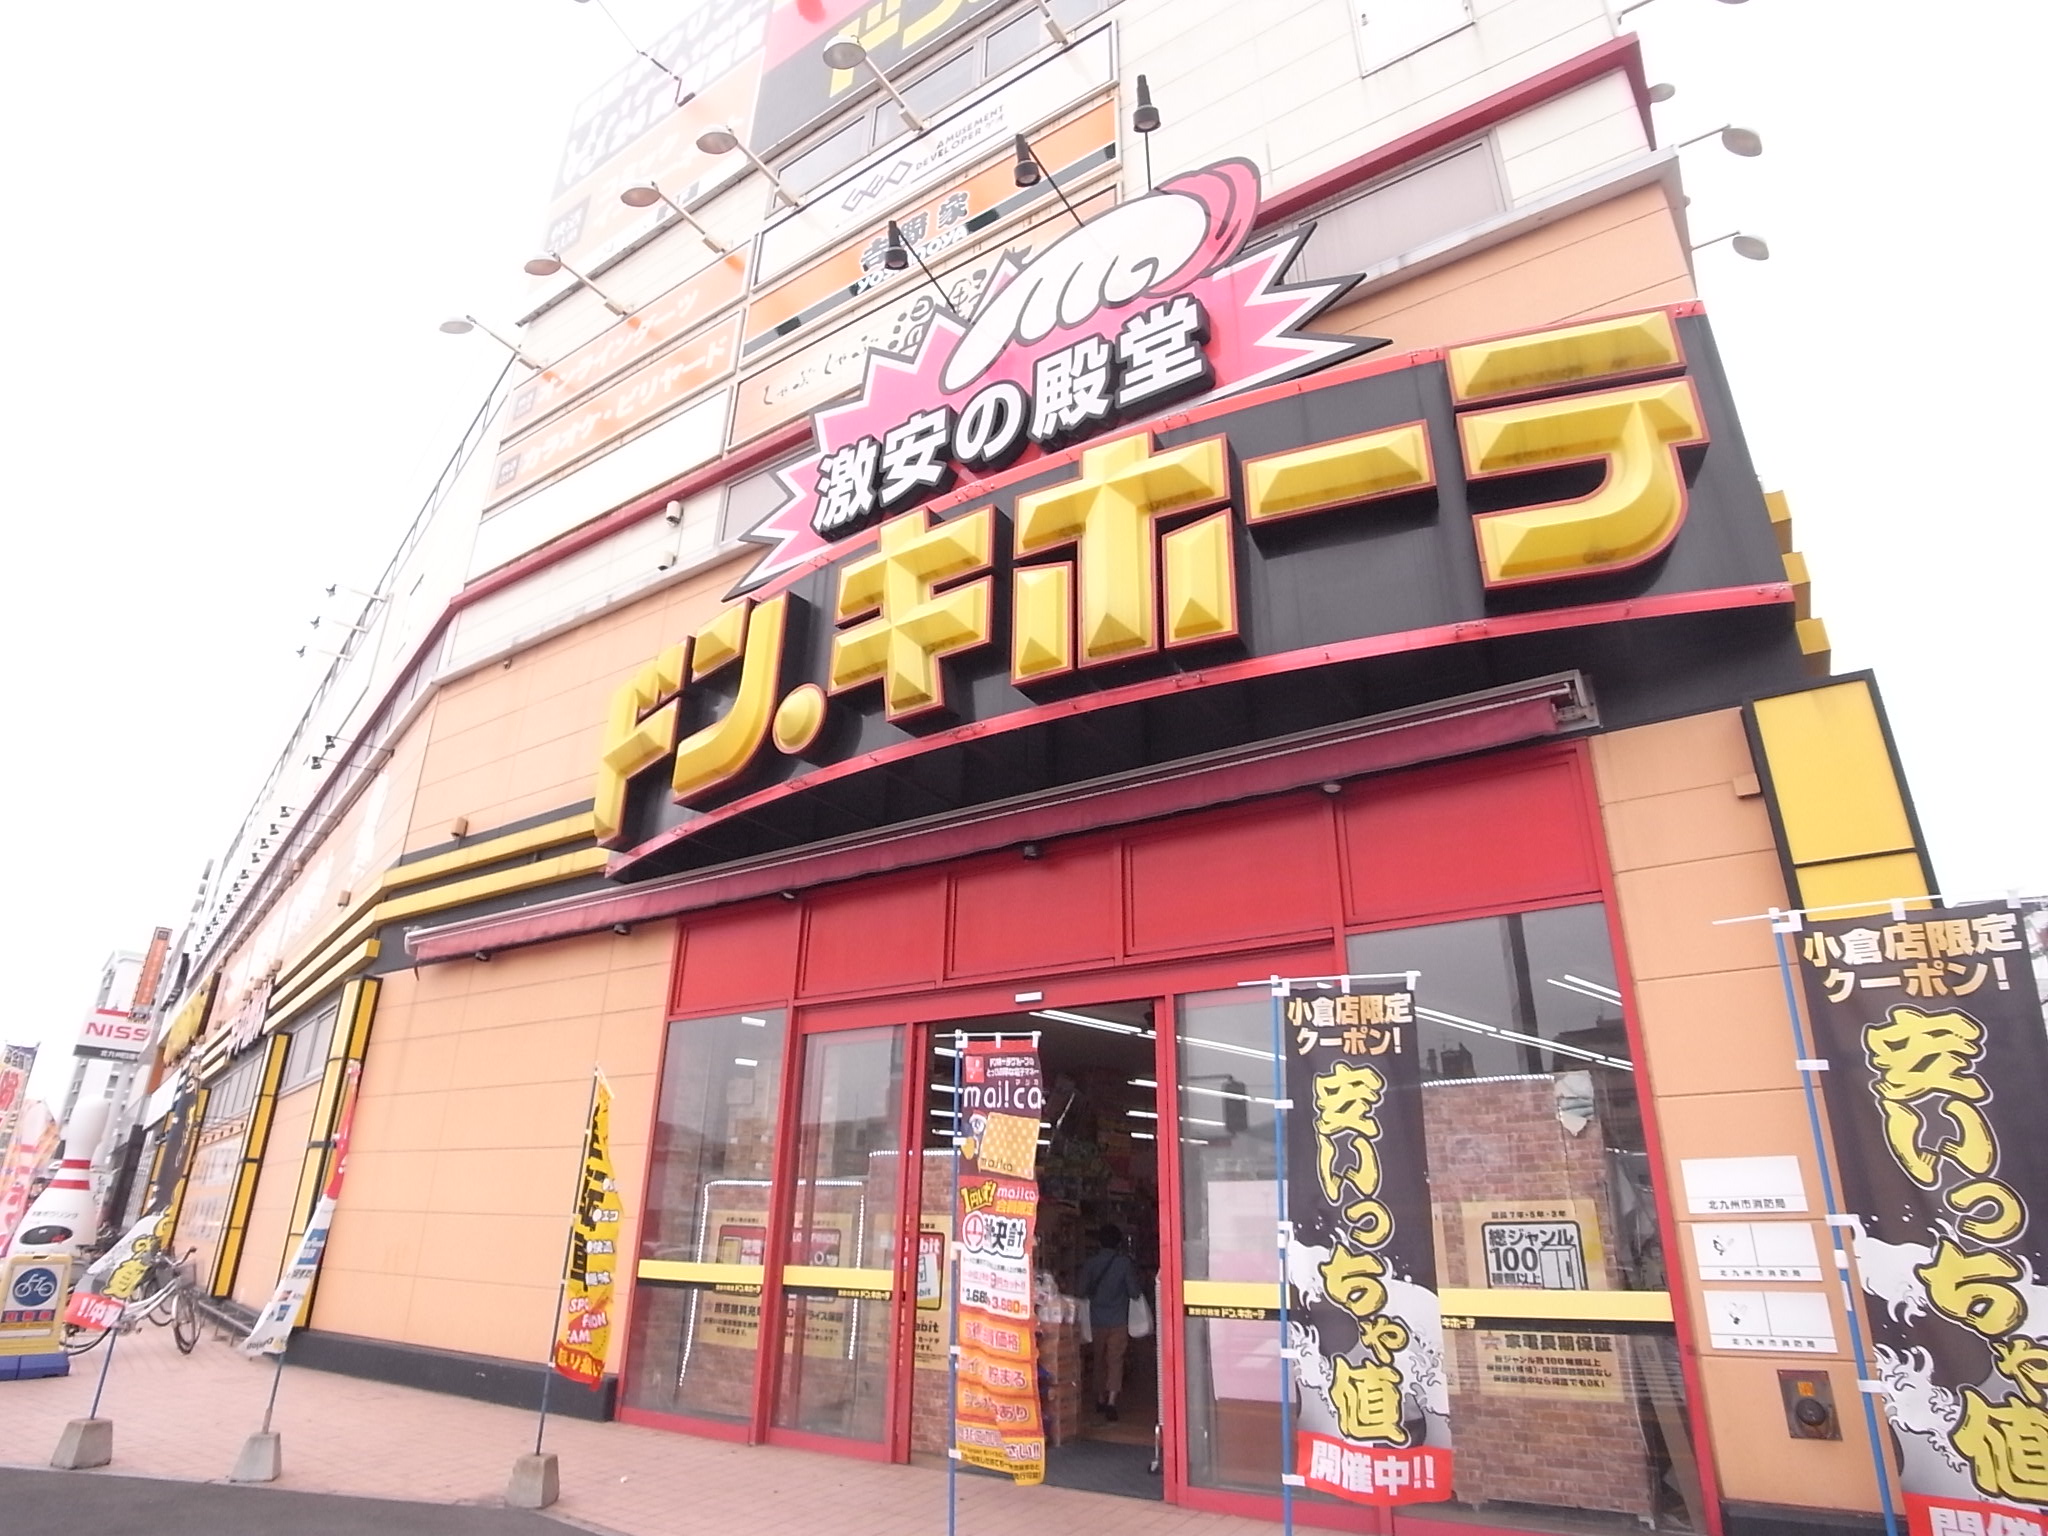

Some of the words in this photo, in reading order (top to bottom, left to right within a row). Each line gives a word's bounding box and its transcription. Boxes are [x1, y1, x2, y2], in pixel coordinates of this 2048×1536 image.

[915, 127, 982, 171] DEVELOPER
[936, 104, 1005, 151] AMUSEMENT
[841, 160, 913, 212] GEO
[815, 296, 1205, 532] 激安の殿堂
[1803, 913, 2023, 968] 小倉店限定
[1823, 957, 2011, 1003] クーポン!
[1287, 993, 1413, 1027] 小倉店限定
[1296, 1026, 1402, 1056] クーポン!
[1709, 1198, 1786, 1209] 北九州市消防局
[1312, 1060, 1410, 1448] 安いっちゃ値
[1488, 1229, 1574, 1247] 総ジャンル
[1490, 1247, 1539, 1272] 100
[1720, 1269, 1801, 1277] 北九州市消防局
[1732, 1338, 1817, 1348] 北九州市消防局
[1310, 1441, 1436, 1495] 開催中!!
